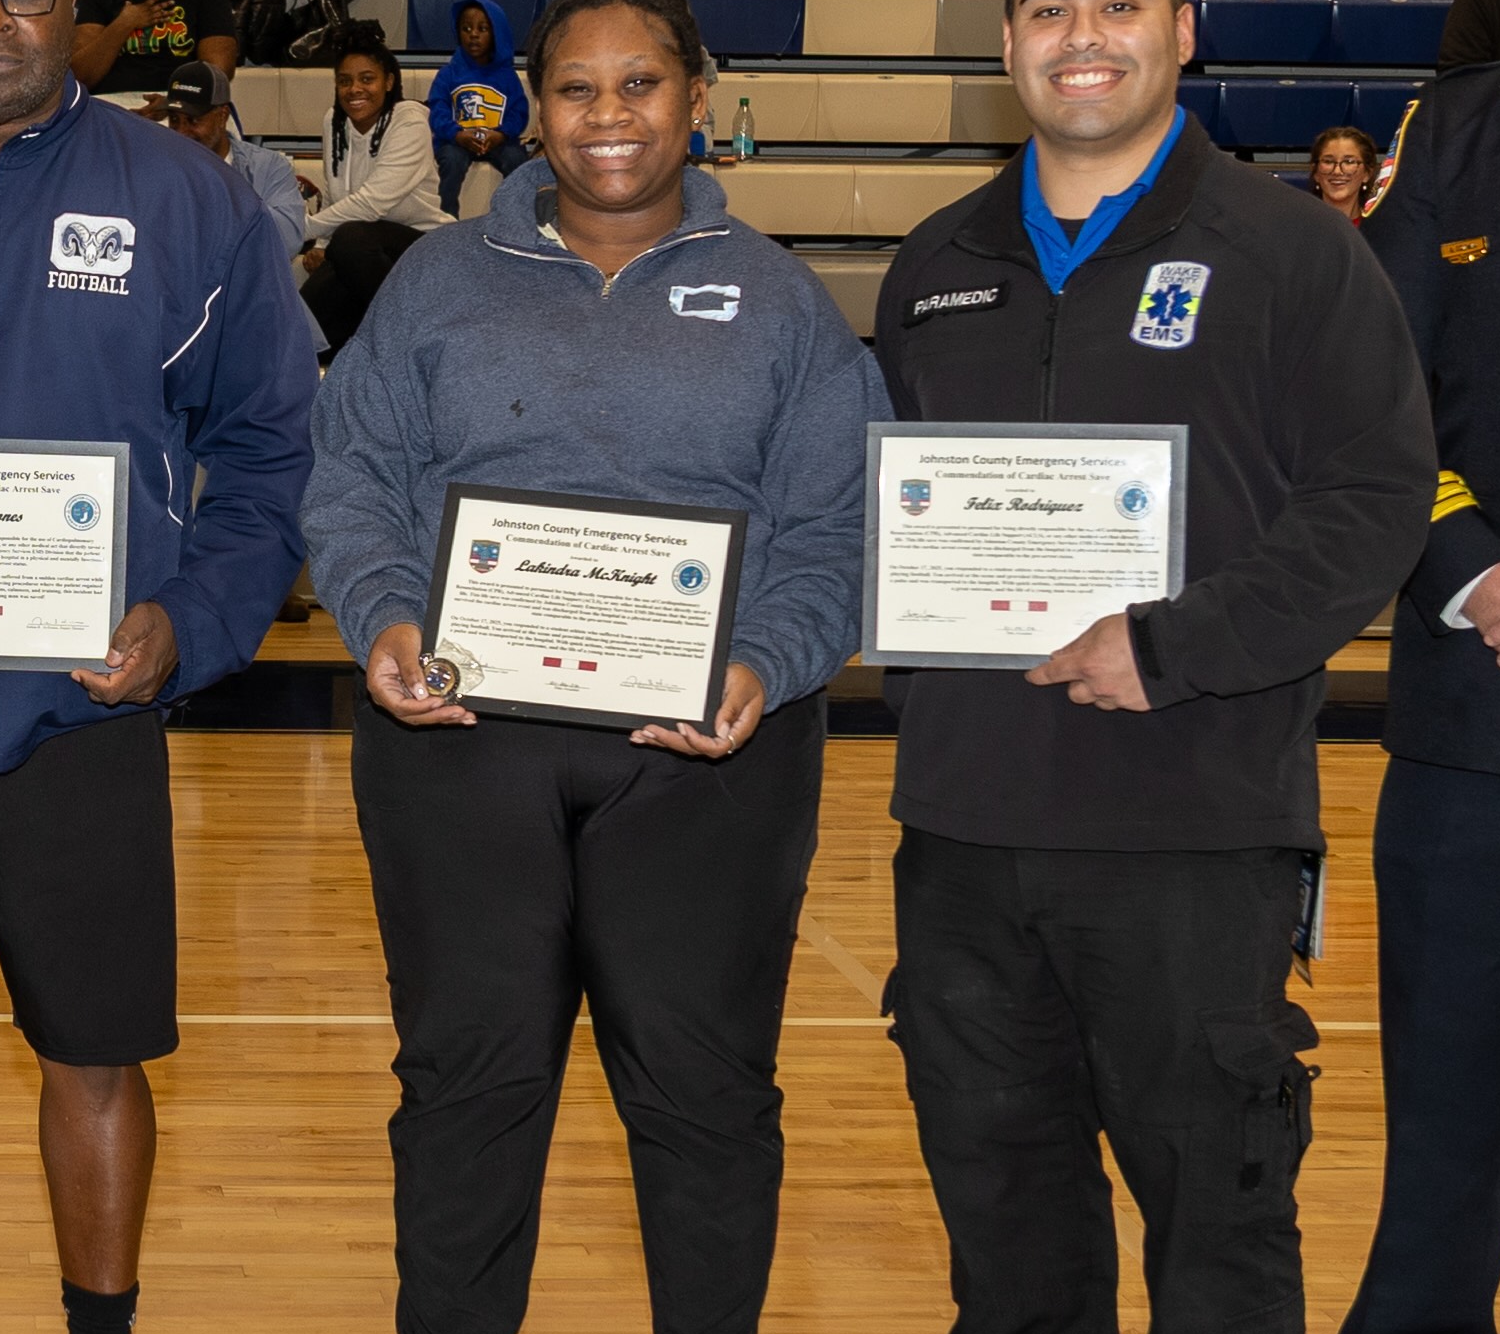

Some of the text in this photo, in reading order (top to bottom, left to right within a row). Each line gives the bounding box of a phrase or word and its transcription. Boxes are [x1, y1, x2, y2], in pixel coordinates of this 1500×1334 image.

[48, 271, 129, 295] FOOTBALL
[913, 287, 998, 316] PARAMEDIC
[1139, 325, 1184, 343] EMS
[34, 470, 75, 481] Services
[964, 497, 1085, 516] Felix Rodriguez
[515, 559, 658, 587] Lakindra McKnight
